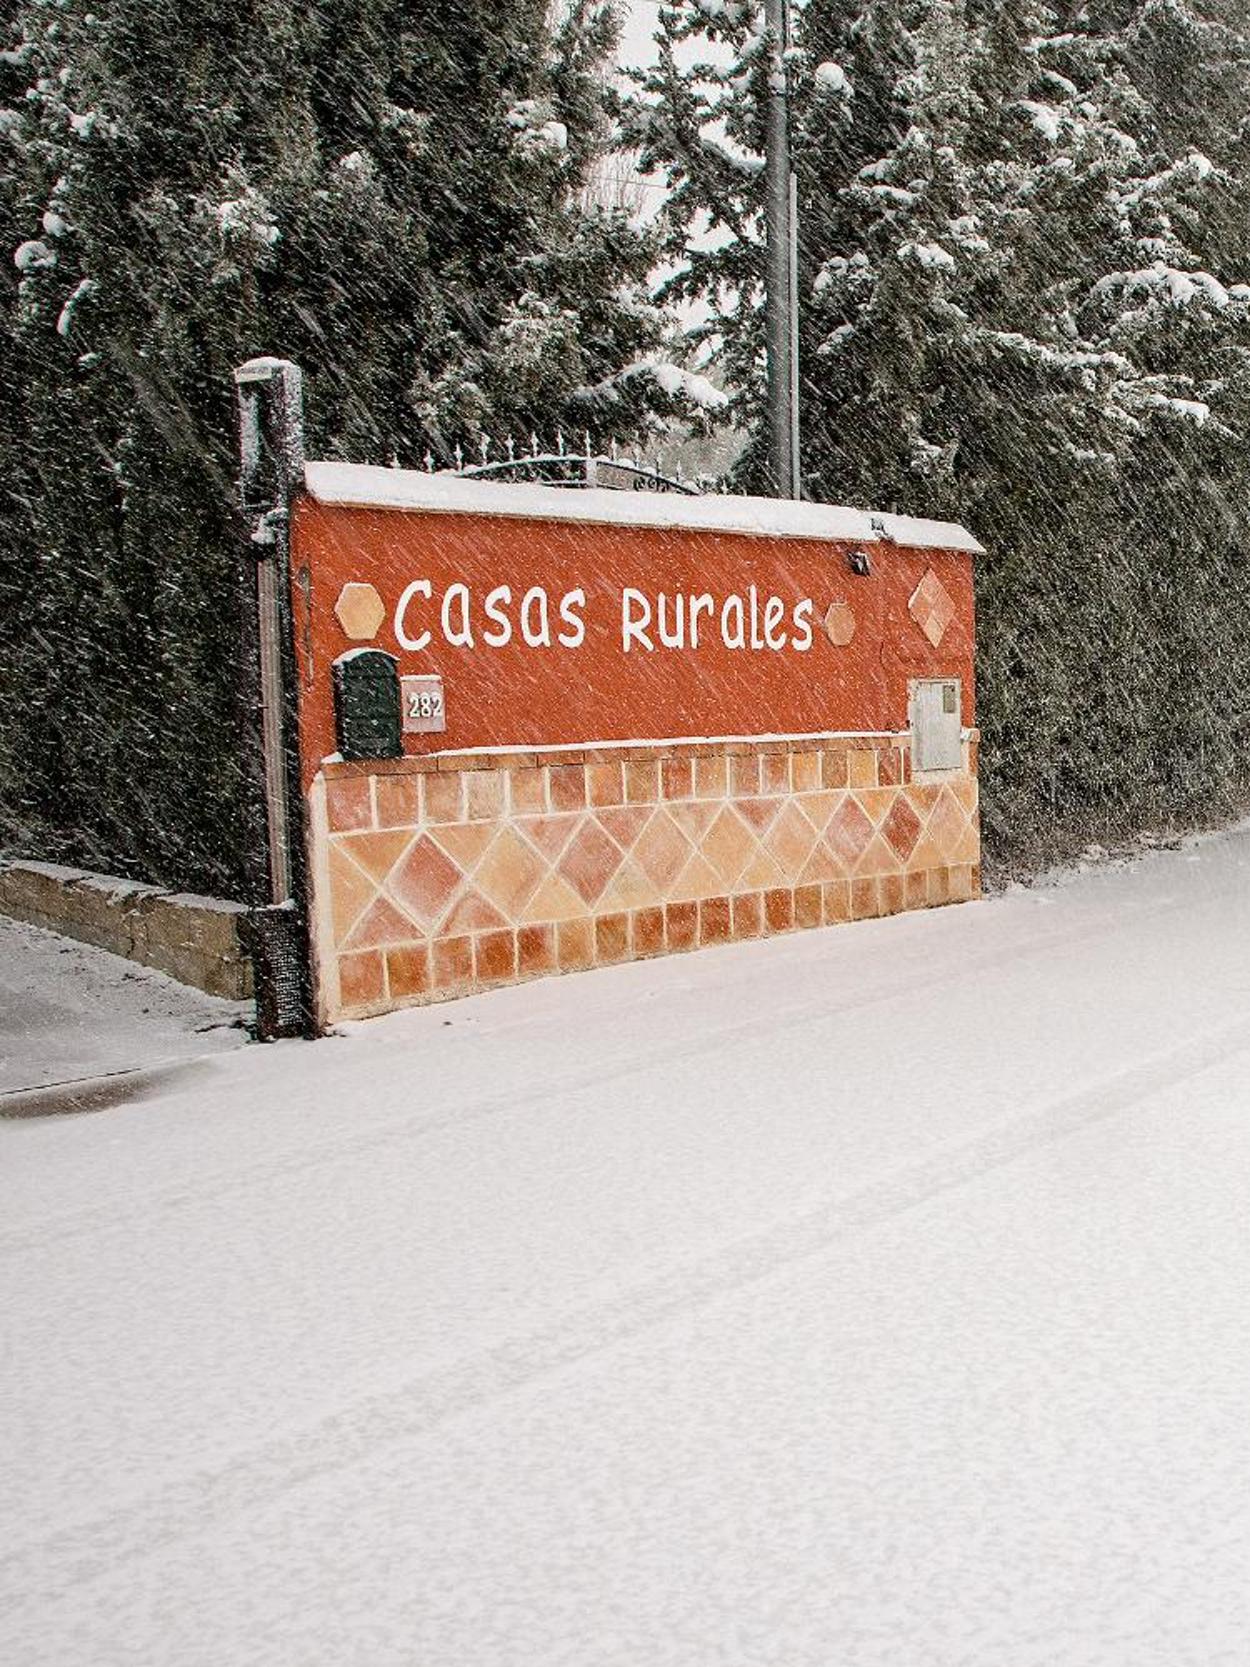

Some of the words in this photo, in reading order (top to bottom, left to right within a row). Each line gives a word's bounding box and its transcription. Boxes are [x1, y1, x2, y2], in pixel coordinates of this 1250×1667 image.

[394, 579, 586, 651] Casas
[622, 585, 814, 652] Rurales
[408, 692, 444, 718] 282
